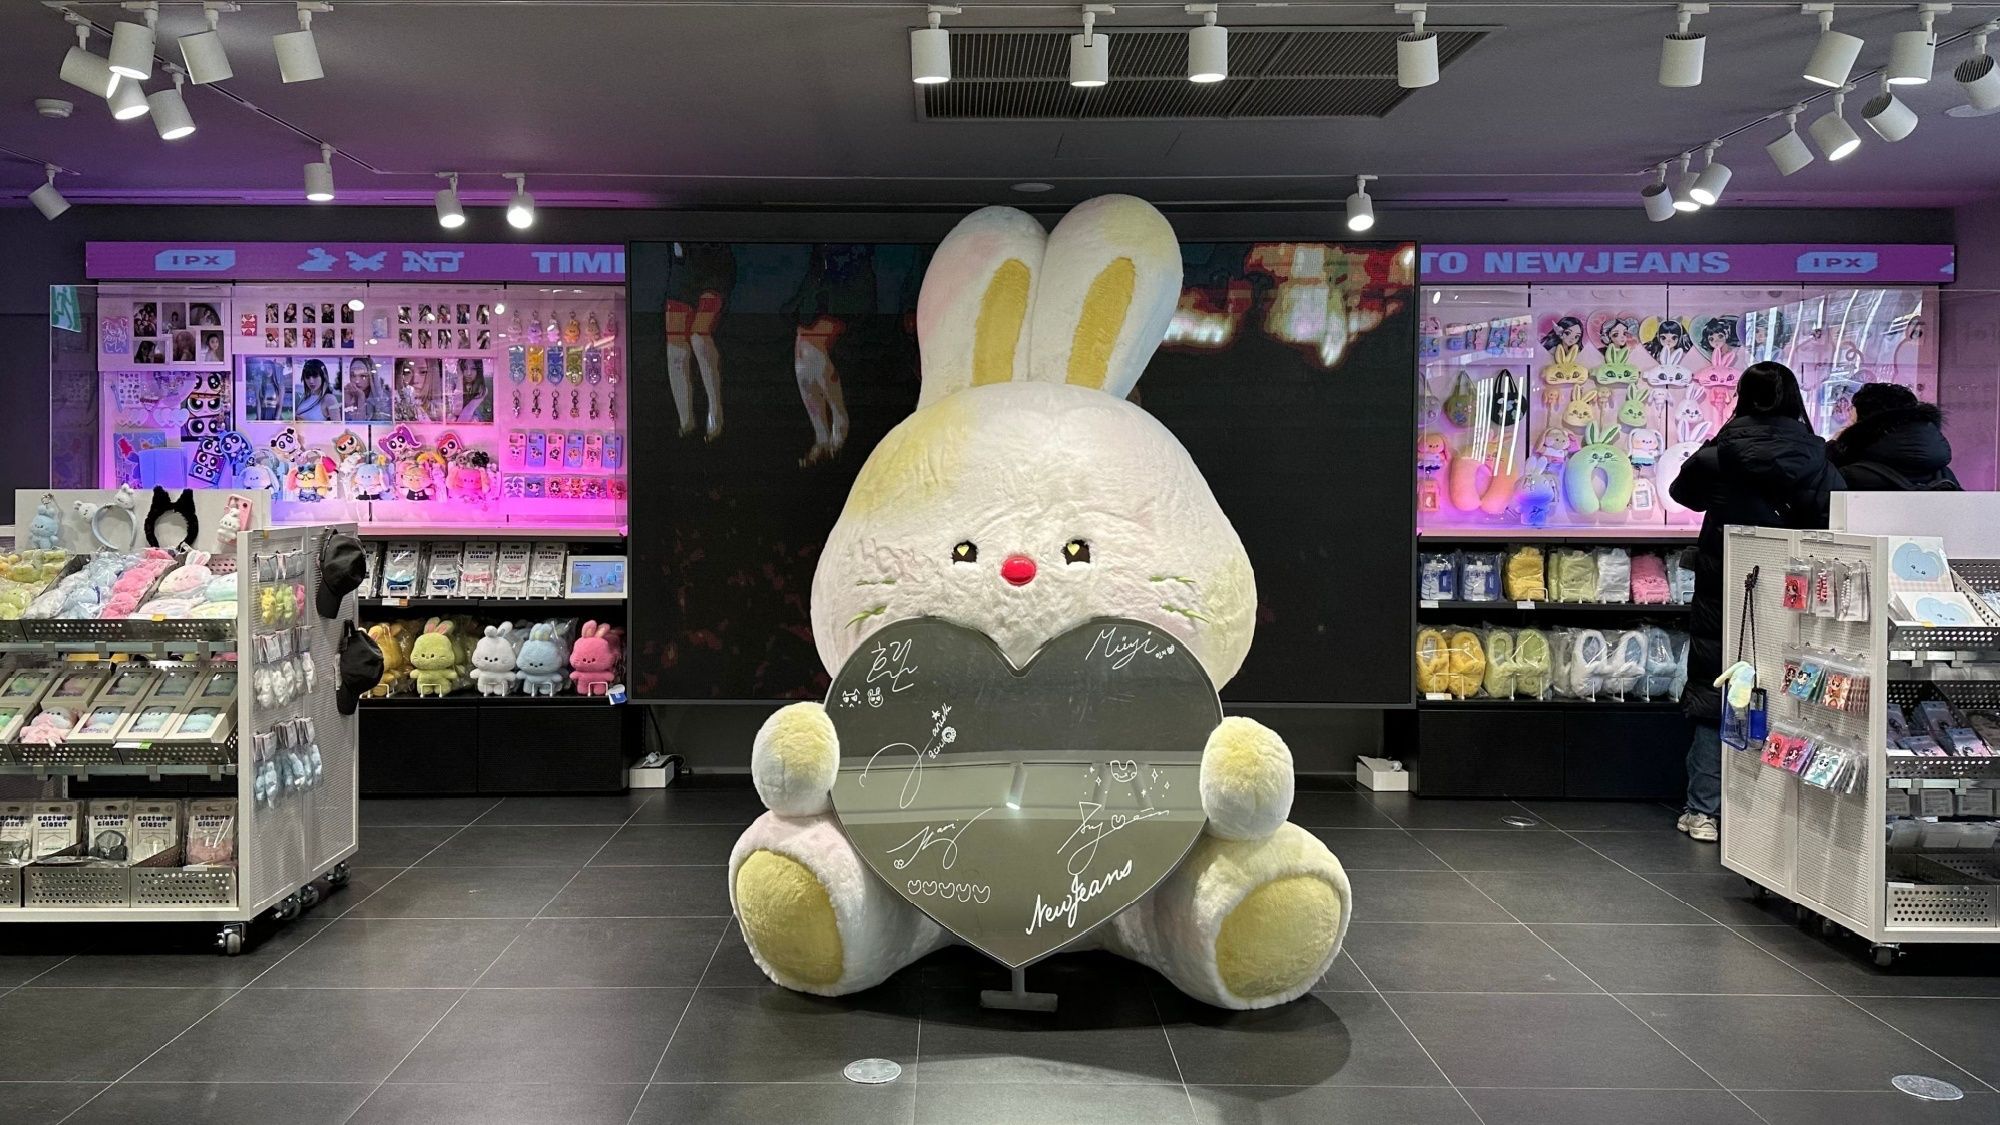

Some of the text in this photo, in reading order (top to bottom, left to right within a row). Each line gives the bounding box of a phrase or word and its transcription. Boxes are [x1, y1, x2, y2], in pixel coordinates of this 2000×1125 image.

[171, 254, 221, 265] IPX
[1421, 251, 1730, 274] TO NEWJEANS
[1813, 257, 1861, 268] IPX
[1025, 860, 1132, 935] NewJeans
